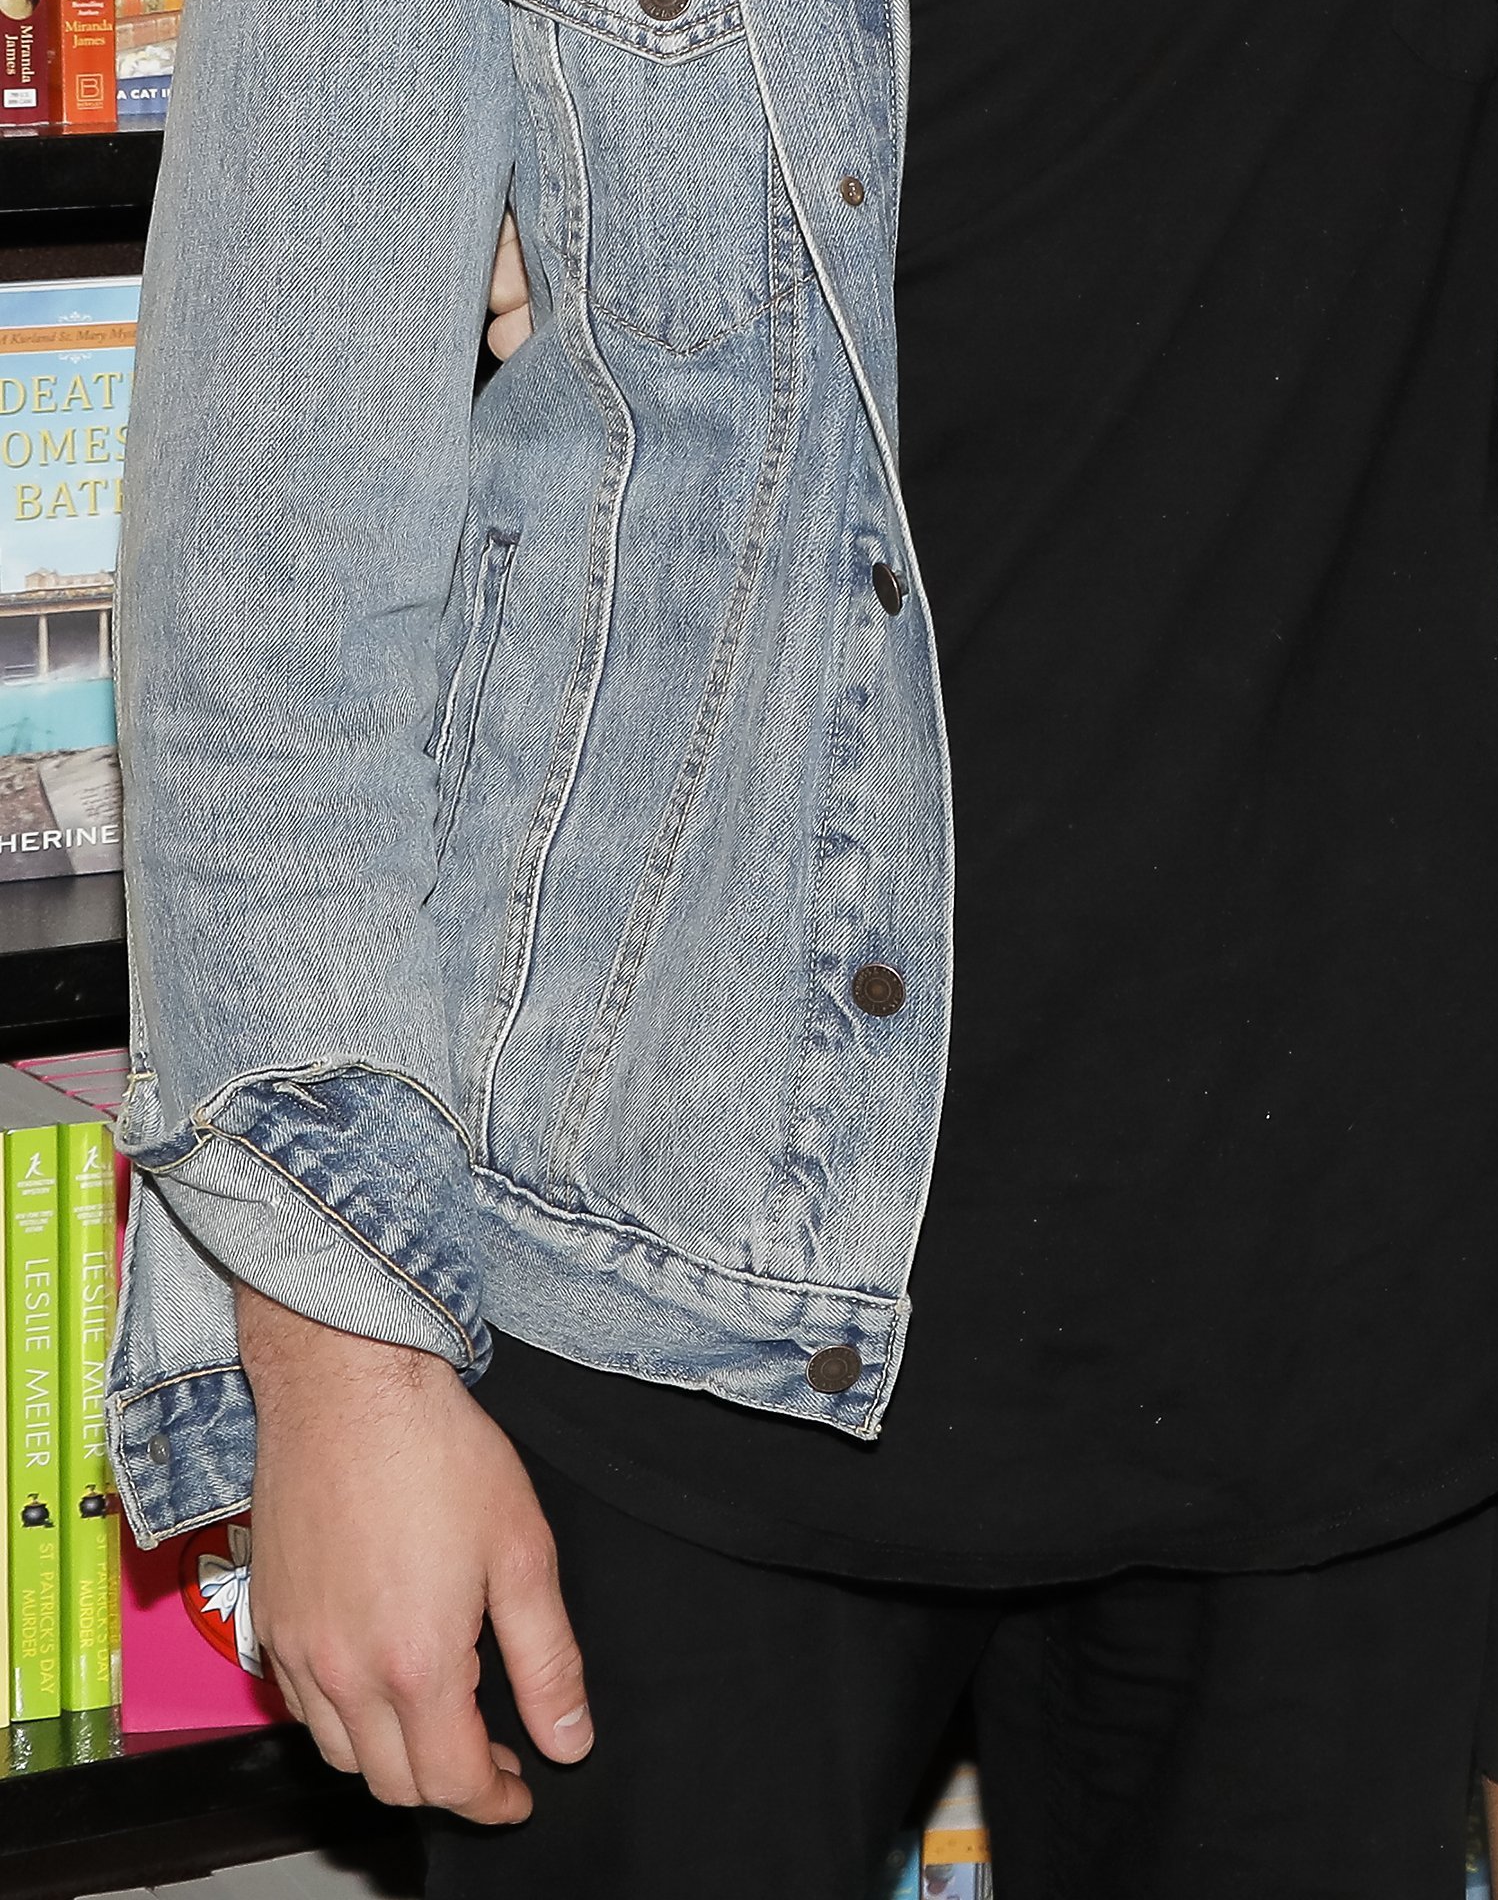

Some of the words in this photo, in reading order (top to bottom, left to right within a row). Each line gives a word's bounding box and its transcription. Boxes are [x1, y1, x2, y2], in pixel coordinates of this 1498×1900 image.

[20, 25, 36, 84] Miranda
[65, 18, 114, 33] Miranda
[130, 88, 158, 99] CAT
[25, 1257, 50, 1352] LESLIE
[83, 1251, 106, 1344] LESLIE
[25, 1368, 50, 1469] MEIER
[22, 1589, 38, 1659] MURDER
[79, 1580, 95, 1649] MURDER
[40, 1658, 55, 1694] DAY
